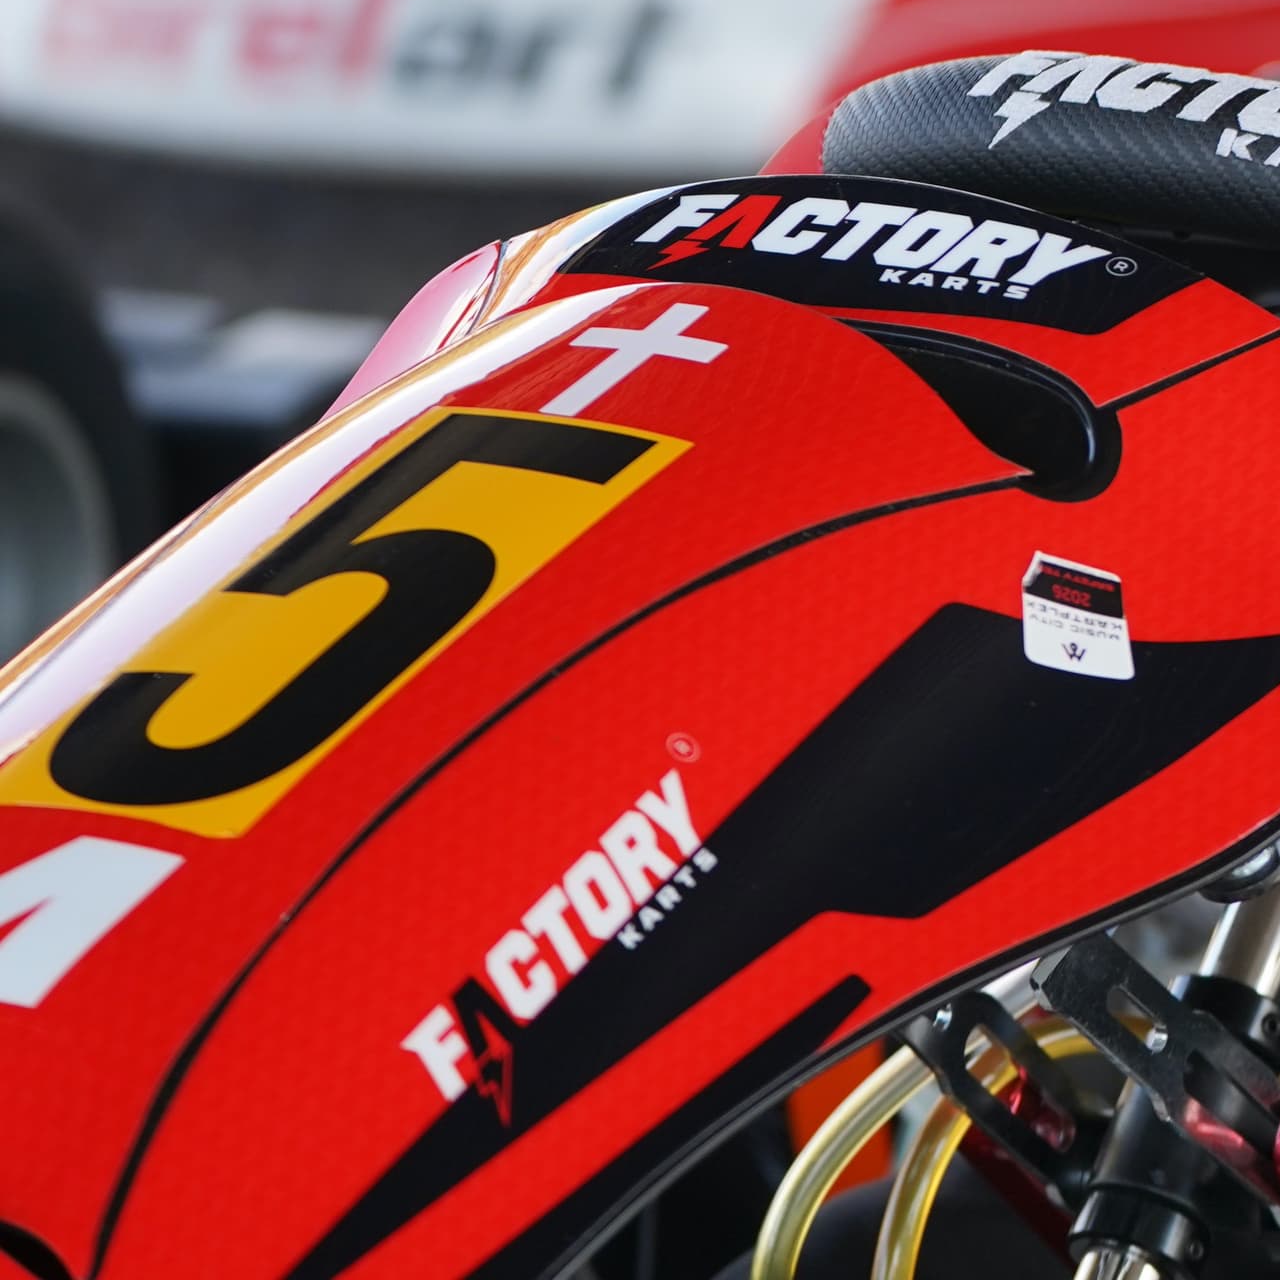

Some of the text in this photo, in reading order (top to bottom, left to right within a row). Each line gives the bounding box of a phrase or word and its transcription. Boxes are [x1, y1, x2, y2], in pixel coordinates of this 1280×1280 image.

[634, 194, 1113, 287] FACTORY
[879, 267, 1030, 300] KARTS
[48, 412, 659, 806] 5
[400, 768, 703, 1120] FACTORY
[617, 847, 719, 950] KARTS
